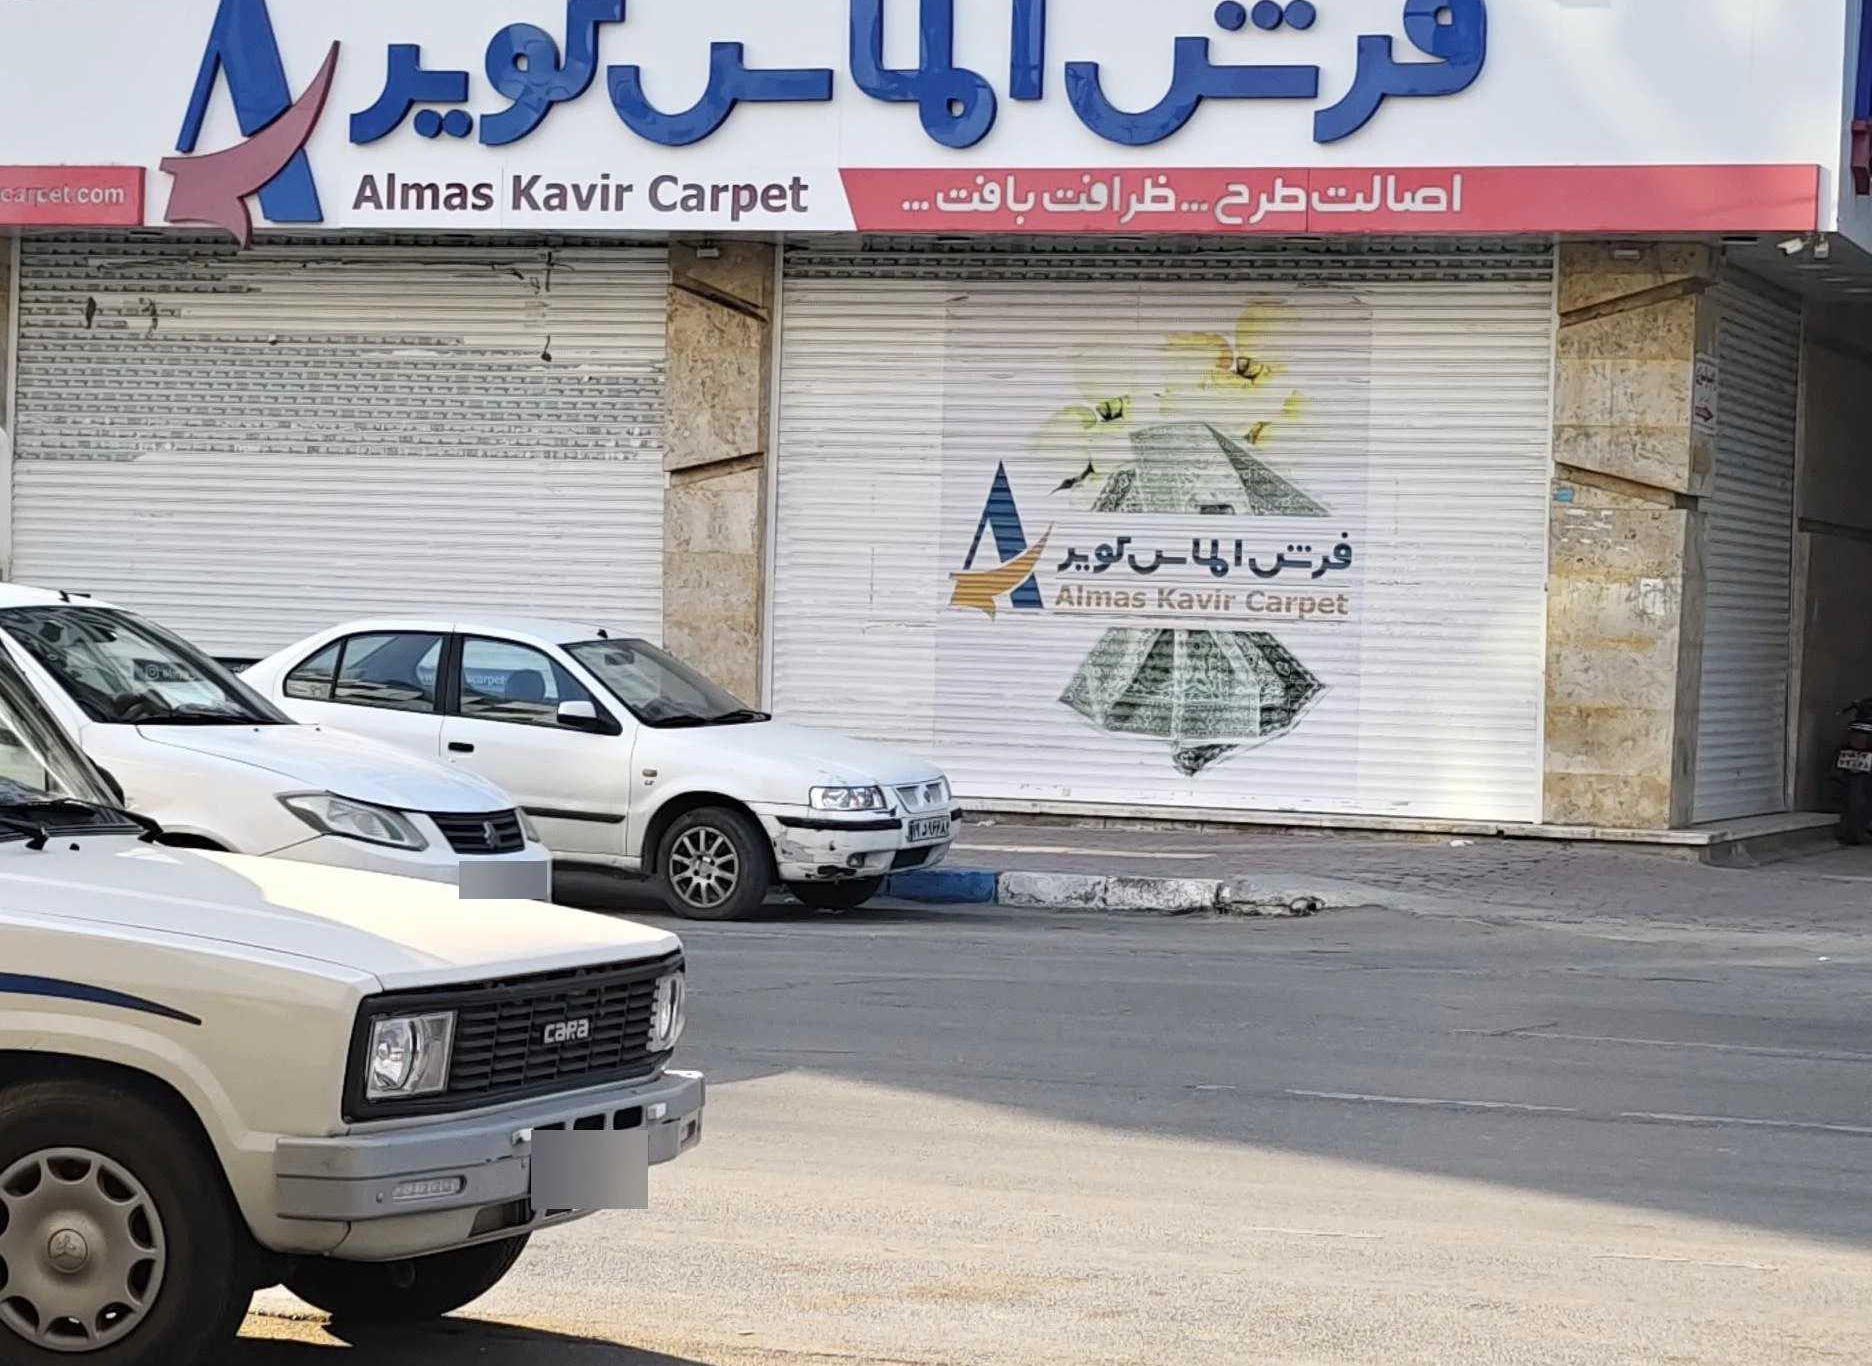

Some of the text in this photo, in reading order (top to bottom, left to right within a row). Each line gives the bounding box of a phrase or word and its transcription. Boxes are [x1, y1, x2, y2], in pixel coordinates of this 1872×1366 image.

[351, 173, 809, 222] Almas Kavir Carpet
[1042, 174, 1177, 224] ظرافت
[1311, 174, 1463, 212] اصالت
[1057, 531, 1353, 579] فرش الماس کویر
[1054, 584, 1350, 619] Almas Kavir Carpet
